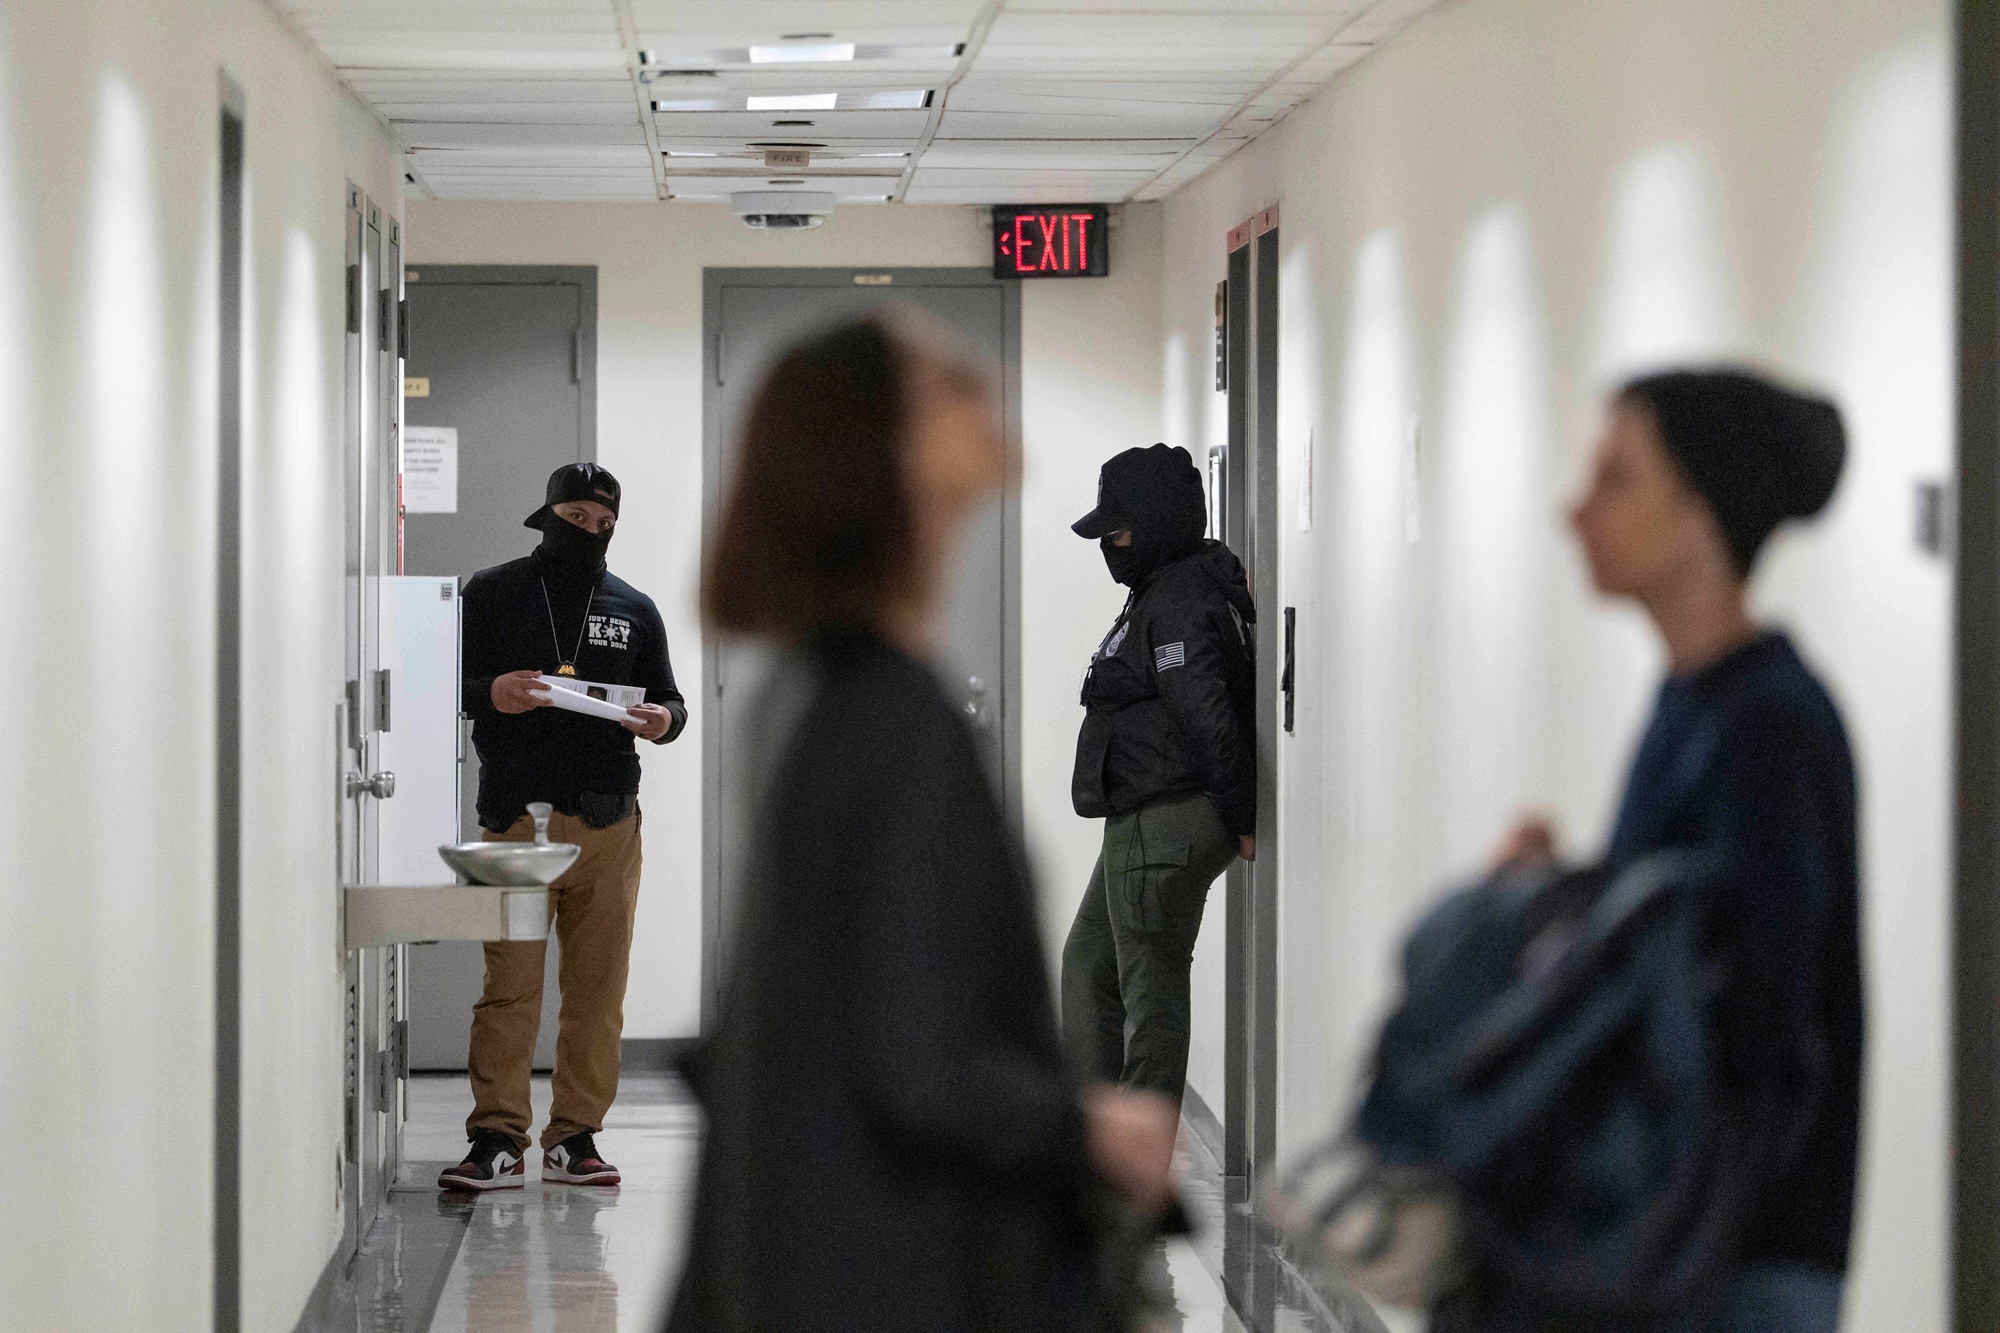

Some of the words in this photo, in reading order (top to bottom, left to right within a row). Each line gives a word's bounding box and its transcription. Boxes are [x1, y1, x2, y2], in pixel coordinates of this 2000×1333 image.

[773, 154, 802, 163] FIRE
[1015, 213, 1094, 272] EXIT
[610, 617, 630, 627] BEING
[588, 622, 630, 642] KY
[610, 641, 627, 650] 2024
